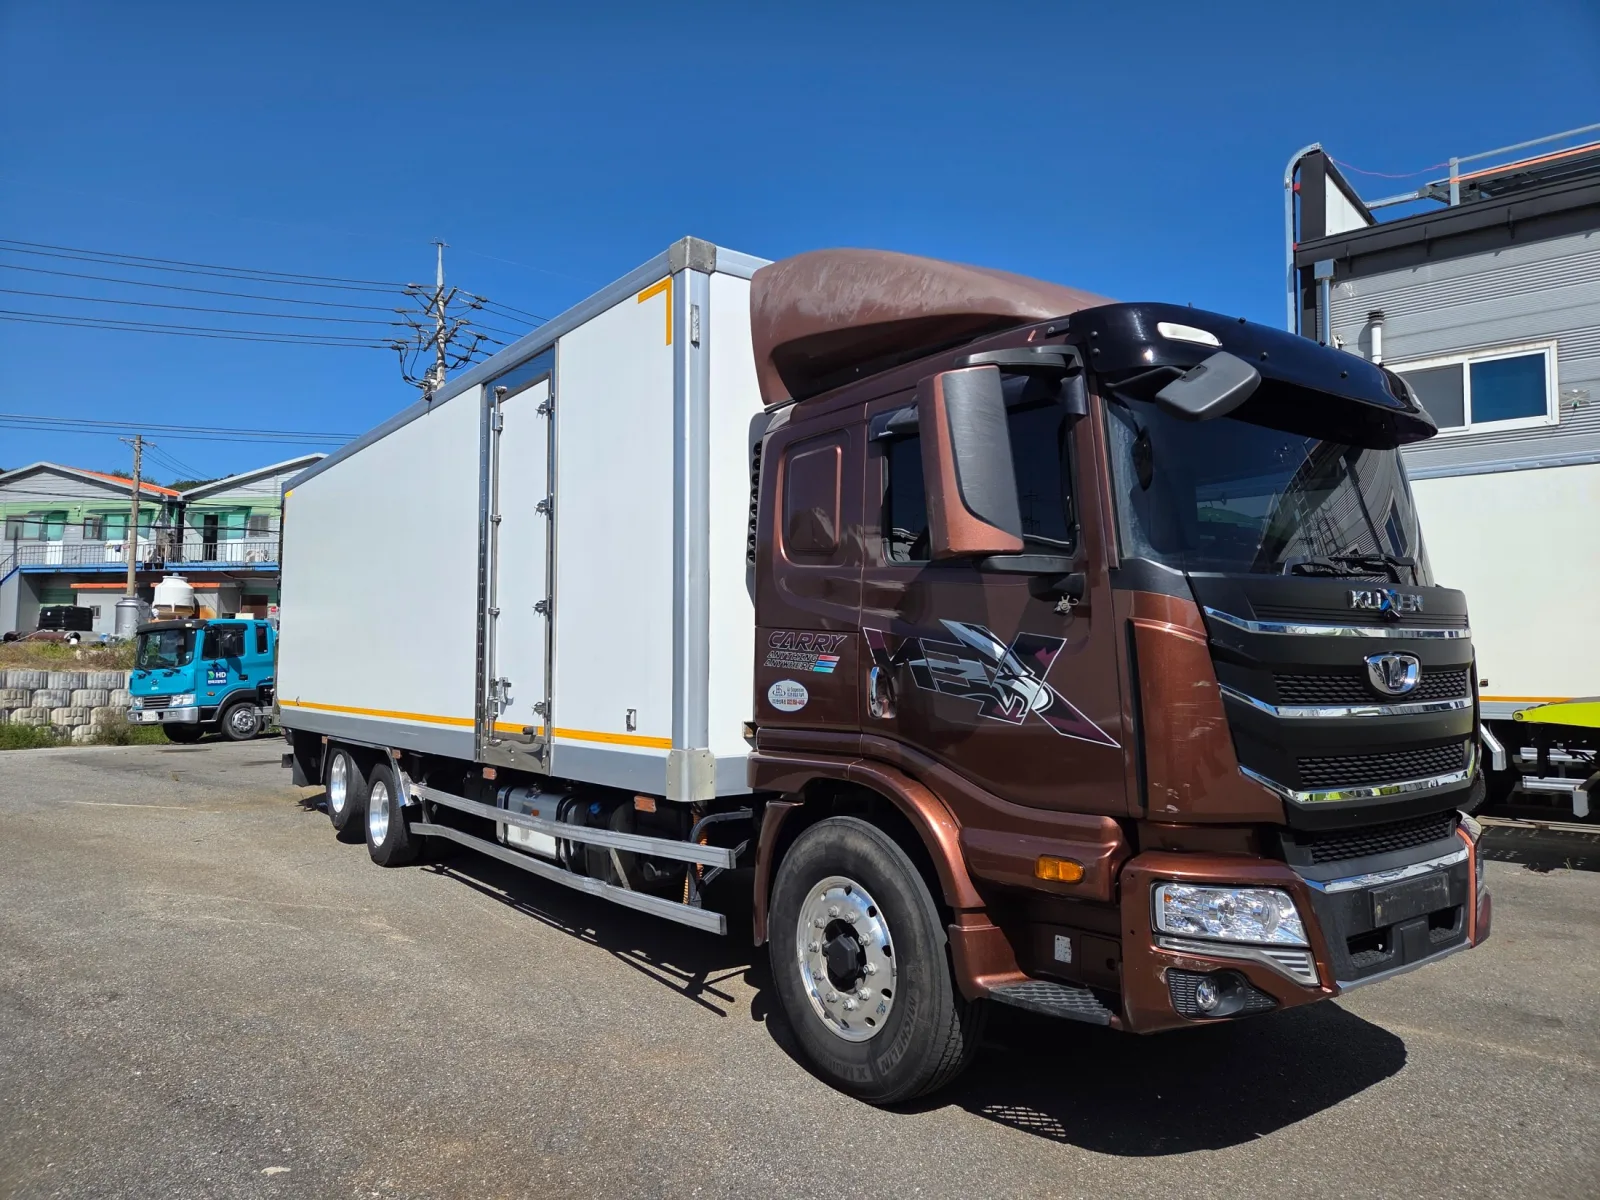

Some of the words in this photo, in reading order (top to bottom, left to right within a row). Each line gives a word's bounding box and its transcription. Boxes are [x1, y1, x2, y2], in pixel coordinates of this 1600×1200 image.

[768, 631, 848, 653] CARRY
[767, 650, 819, 663] ANYTHING
[764, 658, 816, 671] ANYWHERE
[215, 671, 227, 679] HD
[880, 995, 916, 1074] MICHELIN
